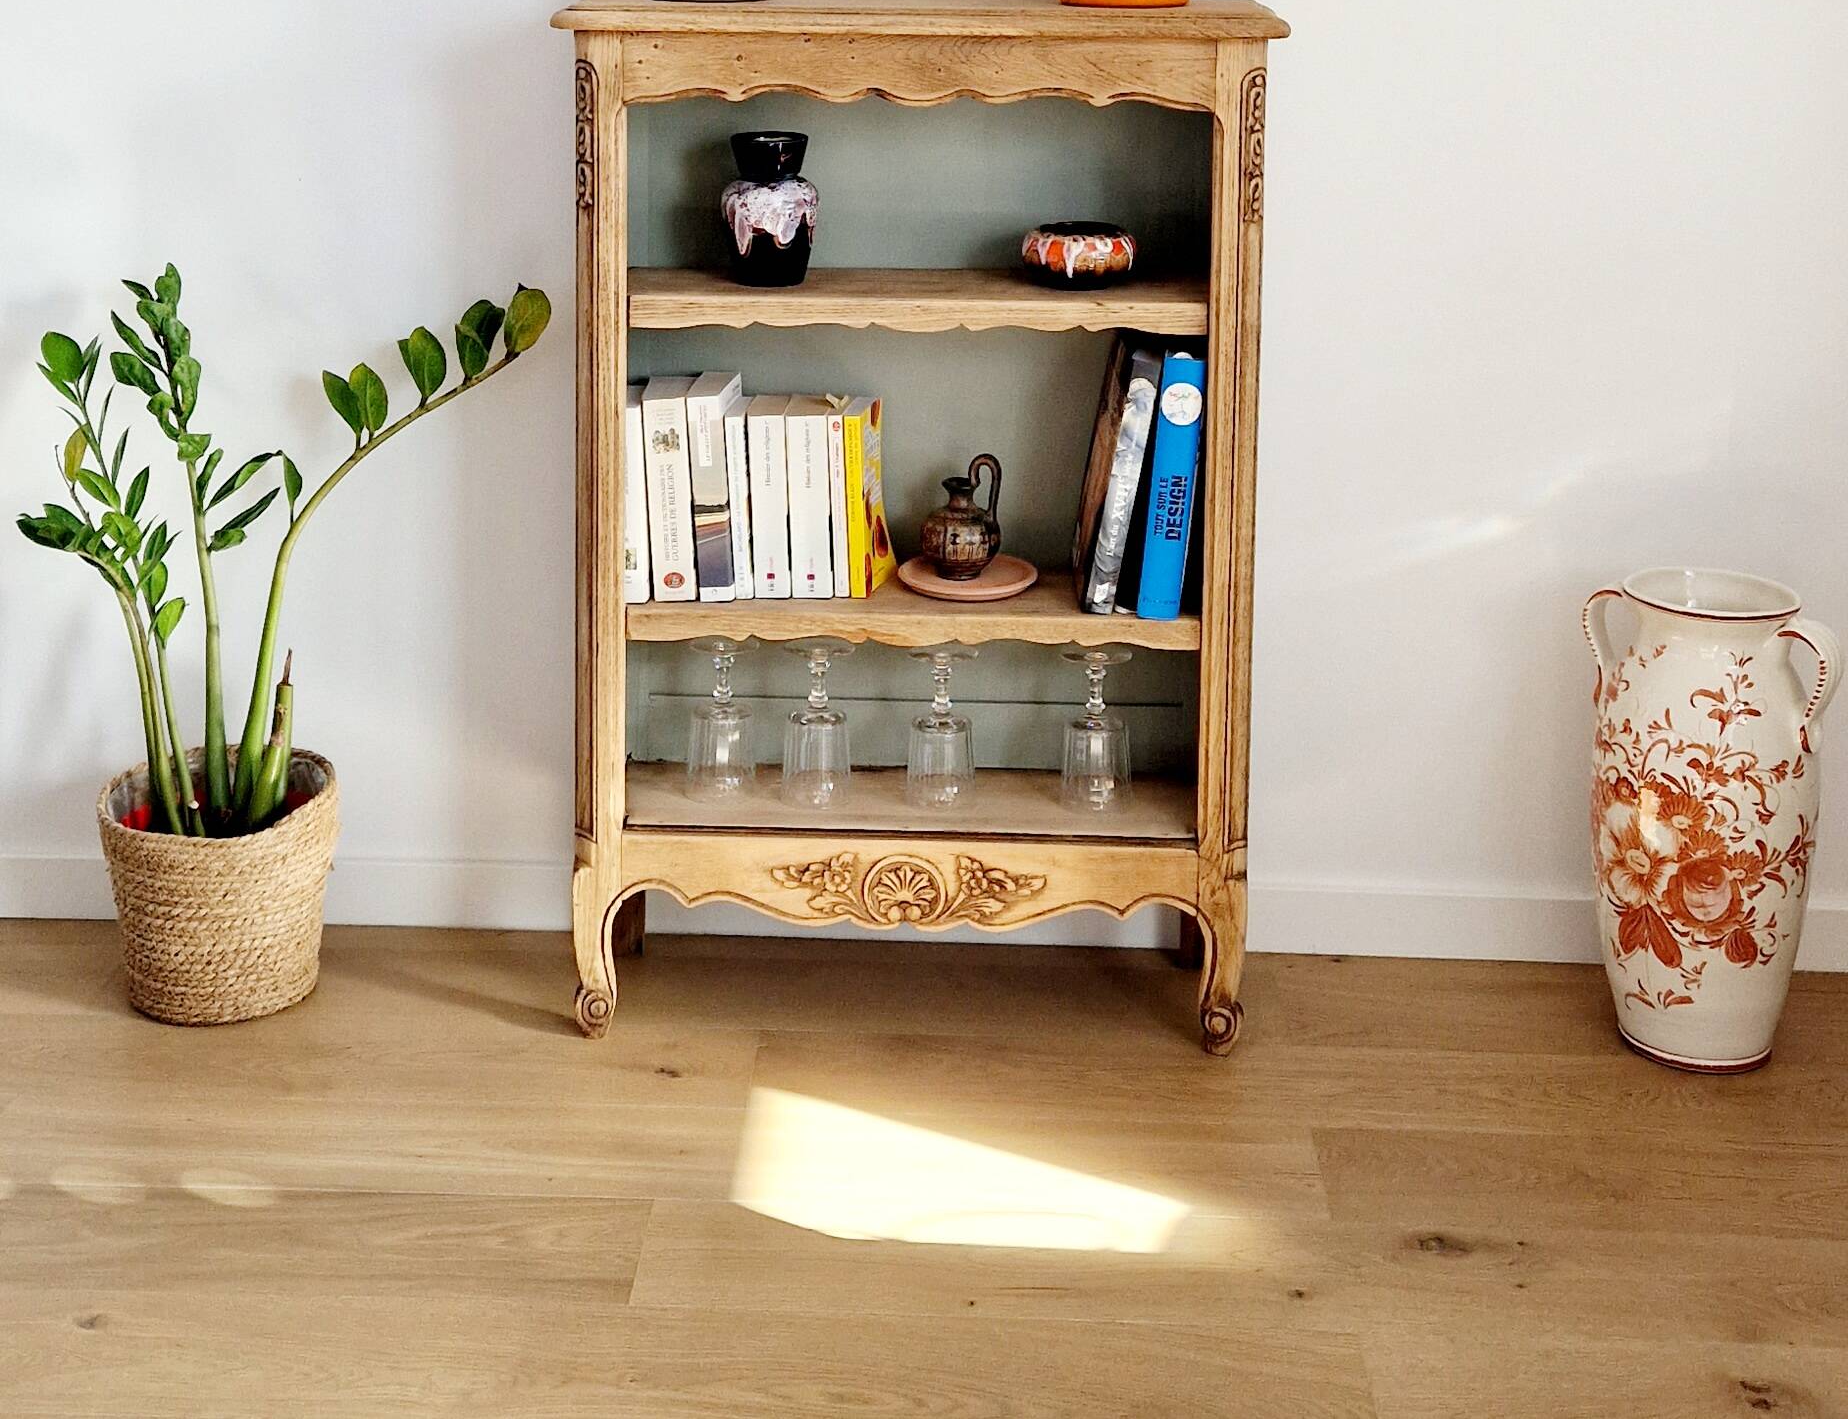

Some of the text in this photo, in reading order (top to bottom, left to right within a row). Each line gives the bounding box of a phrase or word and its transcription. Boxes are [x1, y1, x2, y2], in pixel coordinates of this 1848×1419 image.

[1153, 476, 1169, 536] TOUT SUR LE
[1164, 475, 1188, 542] DESIGN
